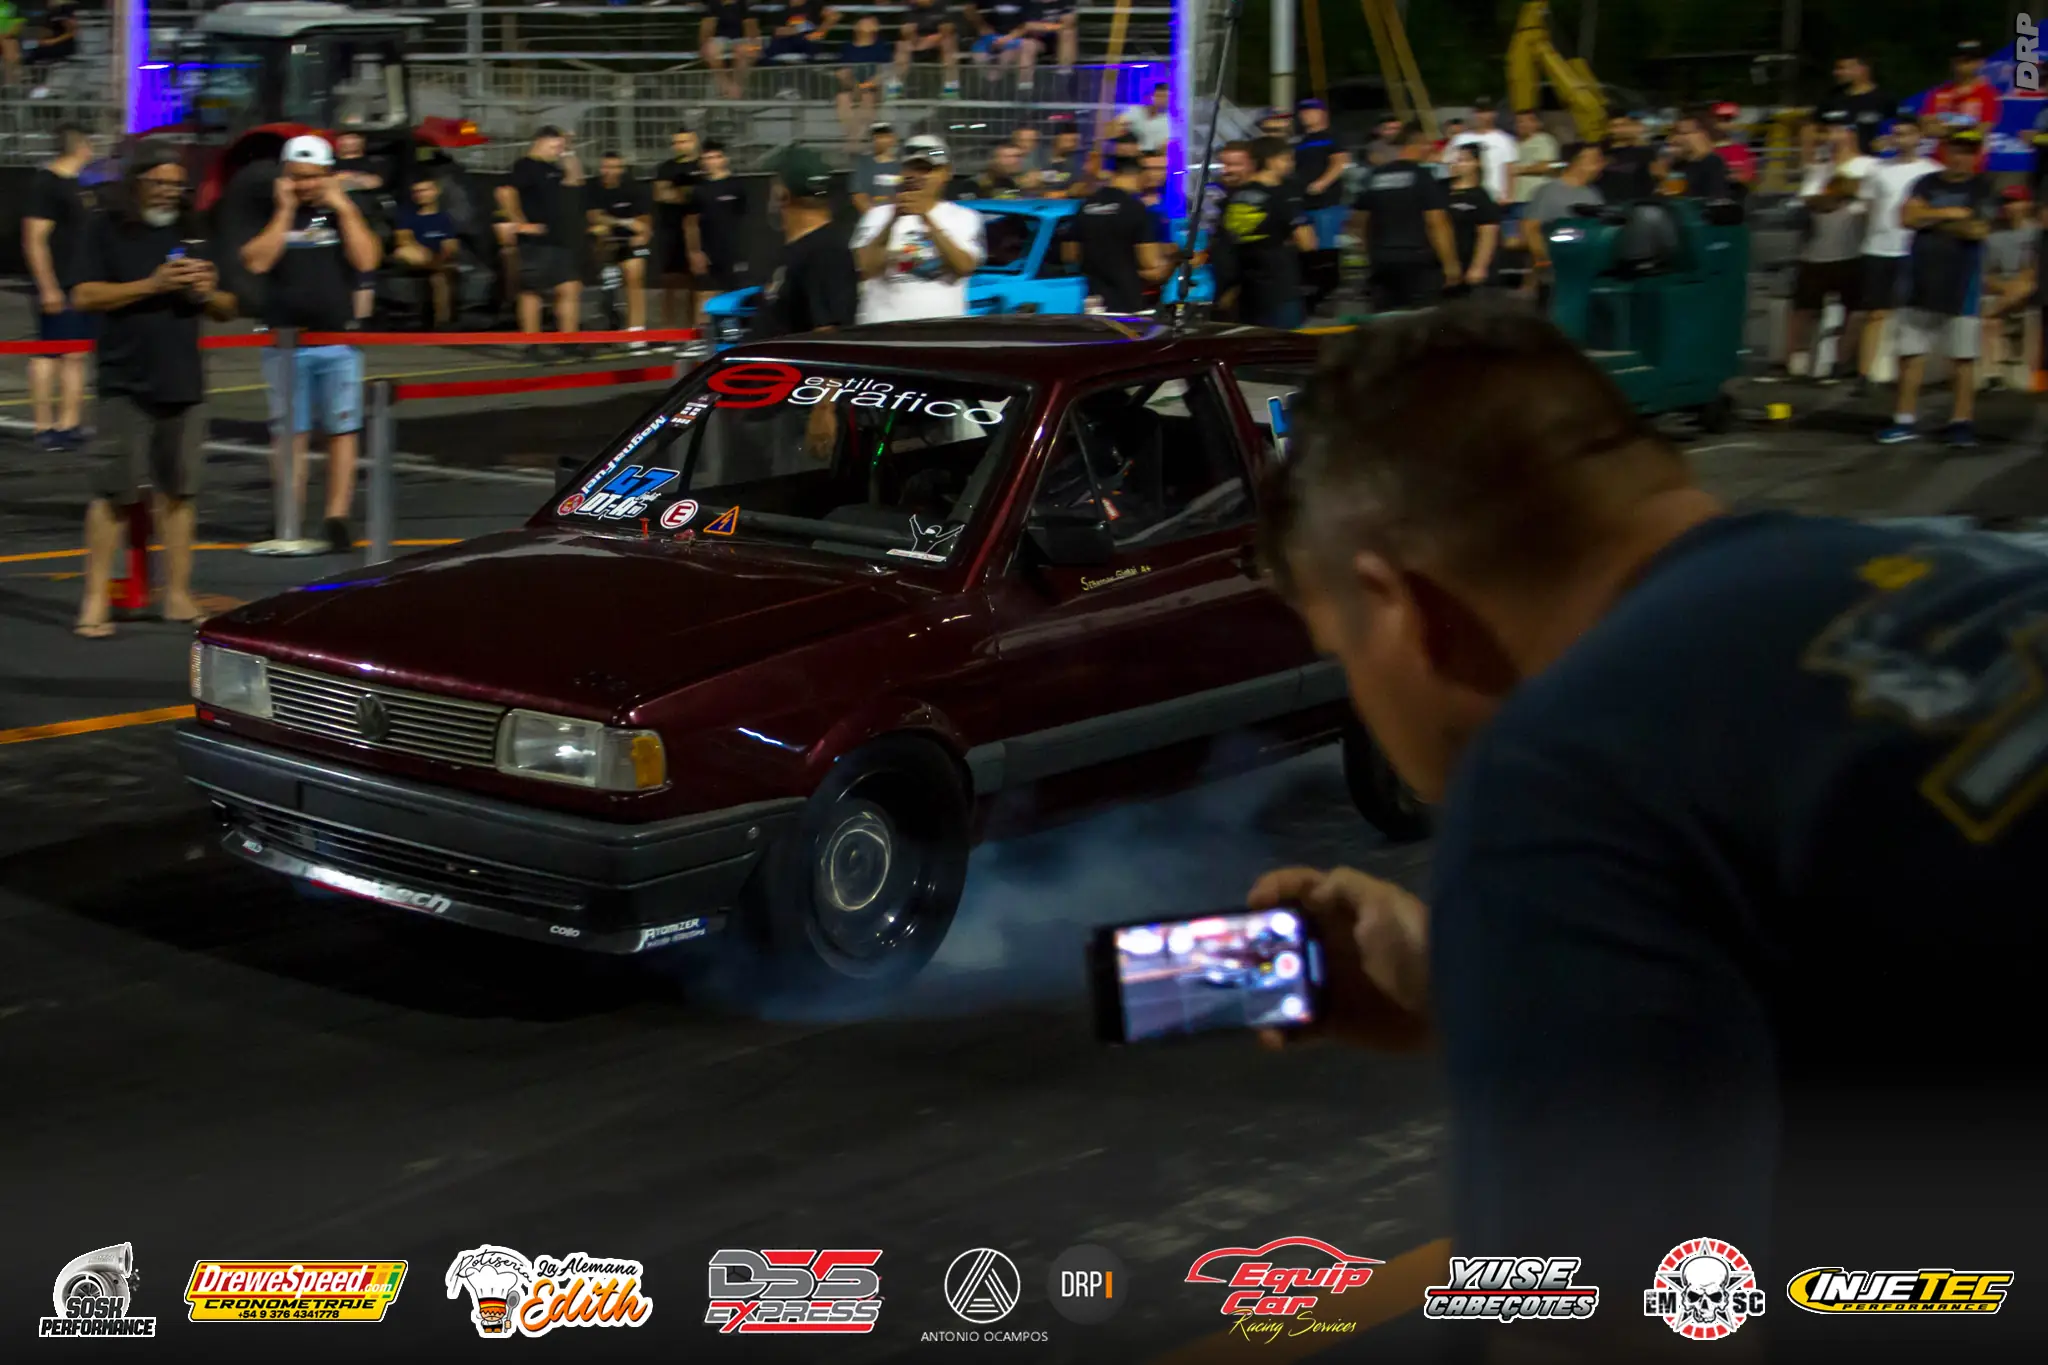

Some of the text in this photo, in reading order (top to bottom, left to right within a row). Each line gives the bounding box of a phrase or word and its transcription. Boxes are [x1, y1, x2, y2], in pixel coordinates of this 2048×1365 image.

[788, 384, 1004, 425] grafico
[804, 376, 894, 393] estilo
[581, 415, 667, 494] MagnaFuel
